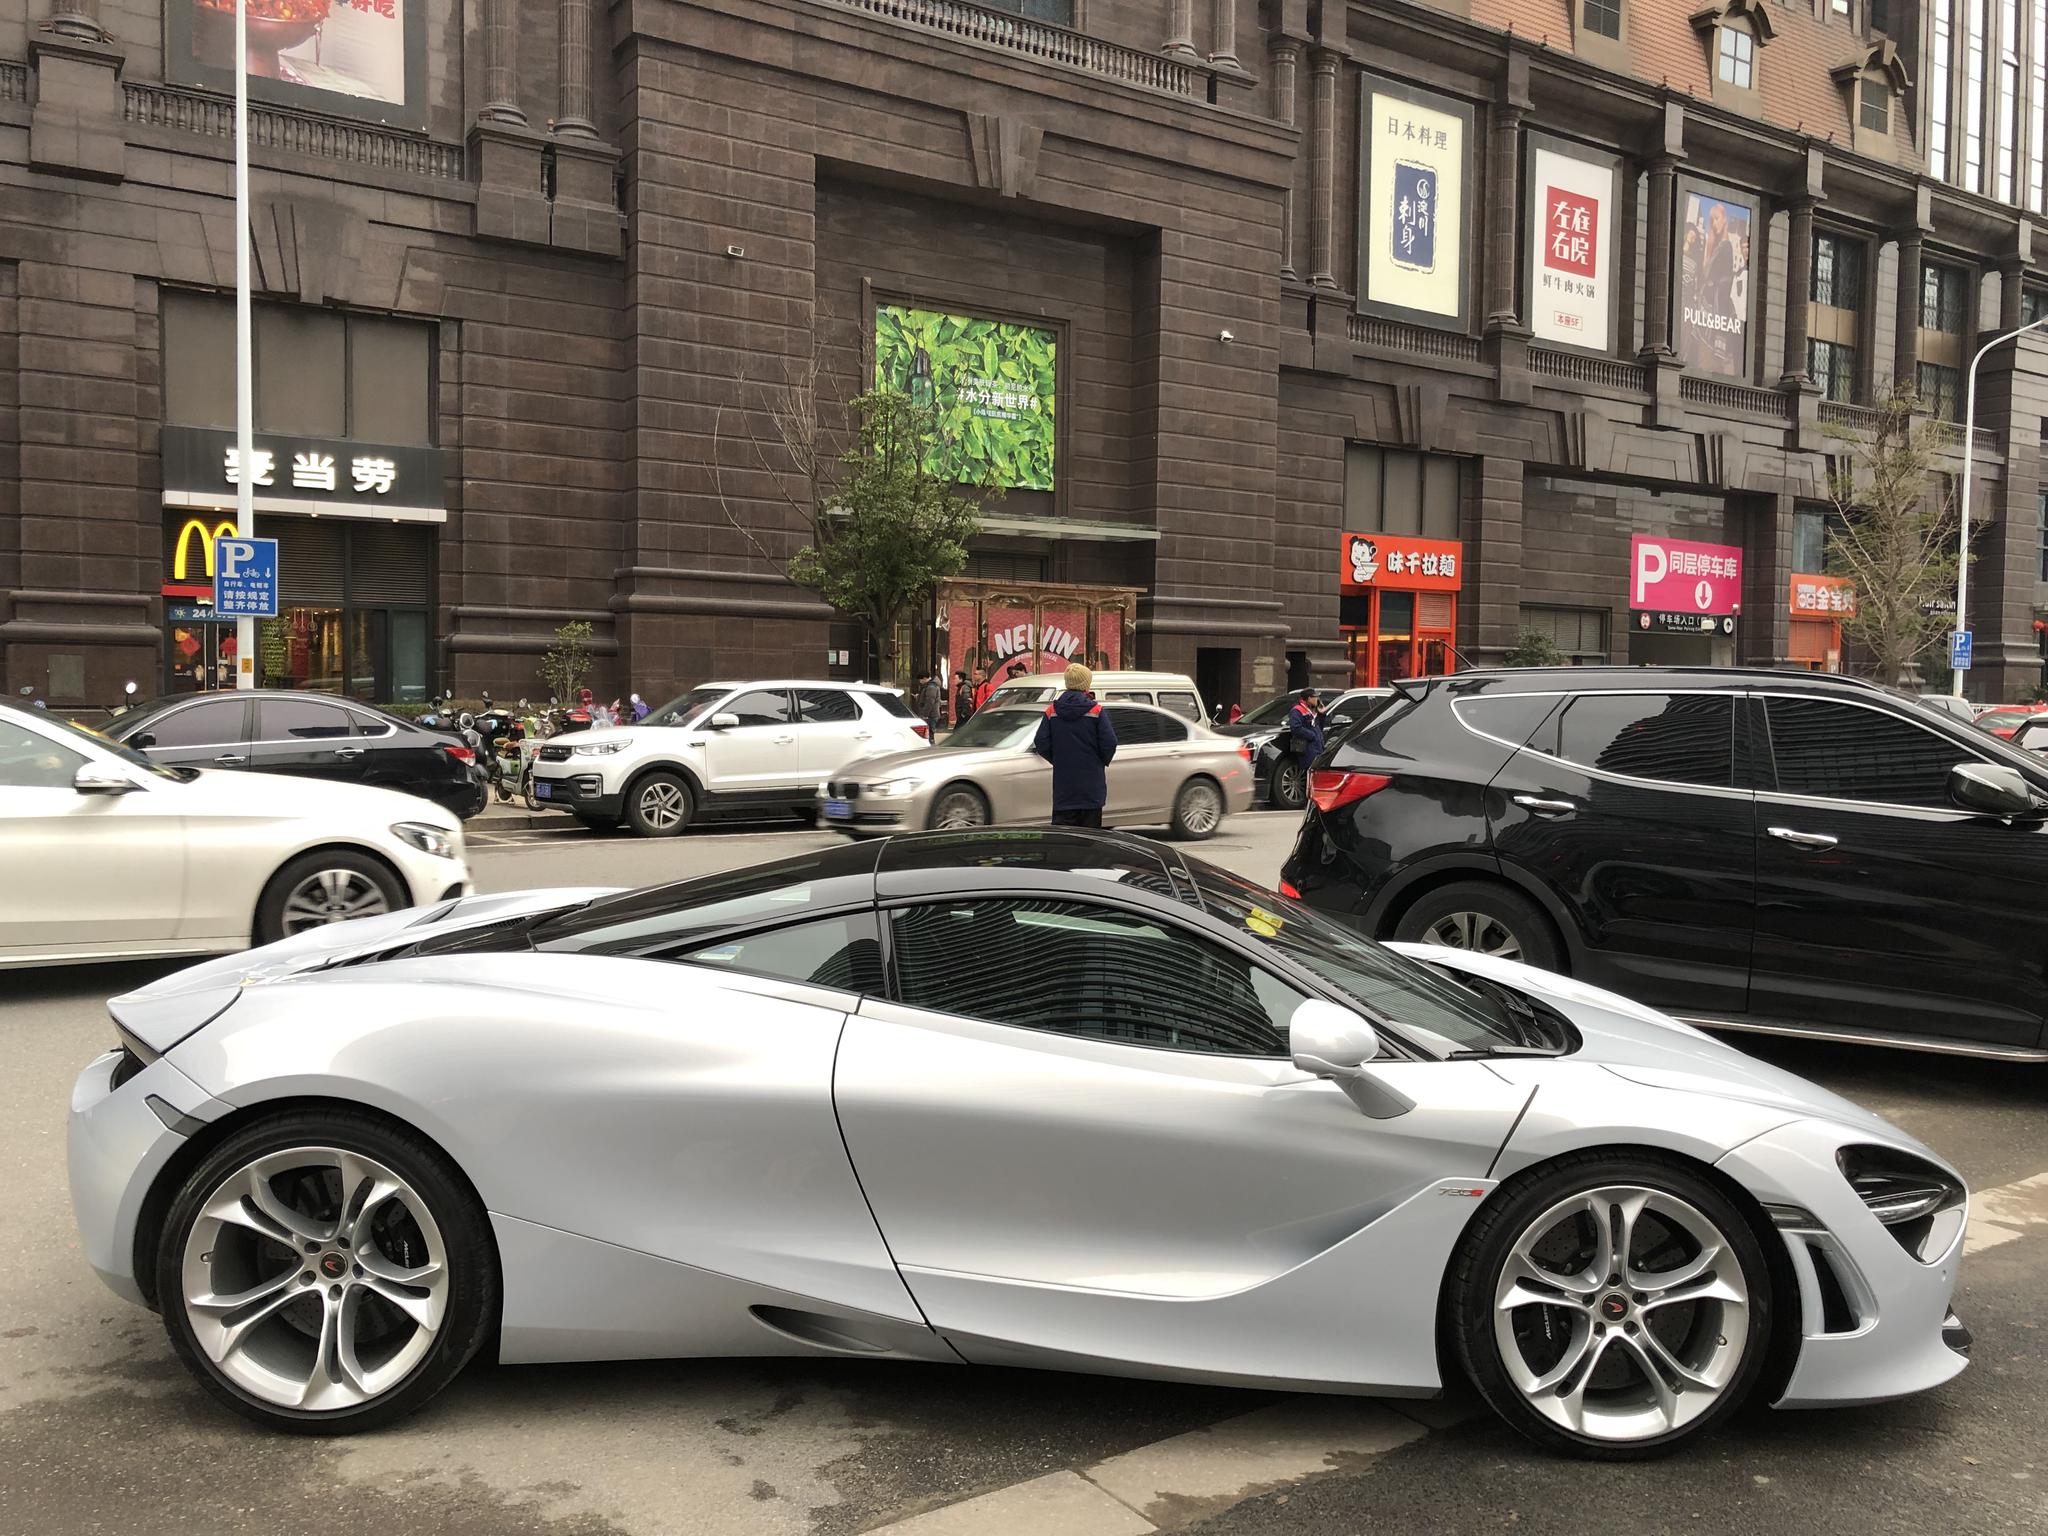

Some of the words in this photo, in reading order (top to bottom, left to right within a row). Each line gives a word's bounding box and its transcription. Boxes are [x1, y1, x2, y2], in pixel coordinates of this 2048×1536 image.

[1388, 116, 1448, 151] 日本料理
[1398, 195, 1416, 255] 刺身
[1543, 273, 1596, 299] 鲜牛肉火锅
[1684, 307, 1742, 335] PULL&BEAR
[224, 448, 396, 494] 麦当劳
[221, 542, 255, 579] P
[1637, 543, 1668, 603] P
[1669, 550, 1738, 580] 同层停车库
[223, 590, 270, 601] 请按规定
[223, 600, 270, 611] 整齐停放
[1955, 634, 1966, 652] P
